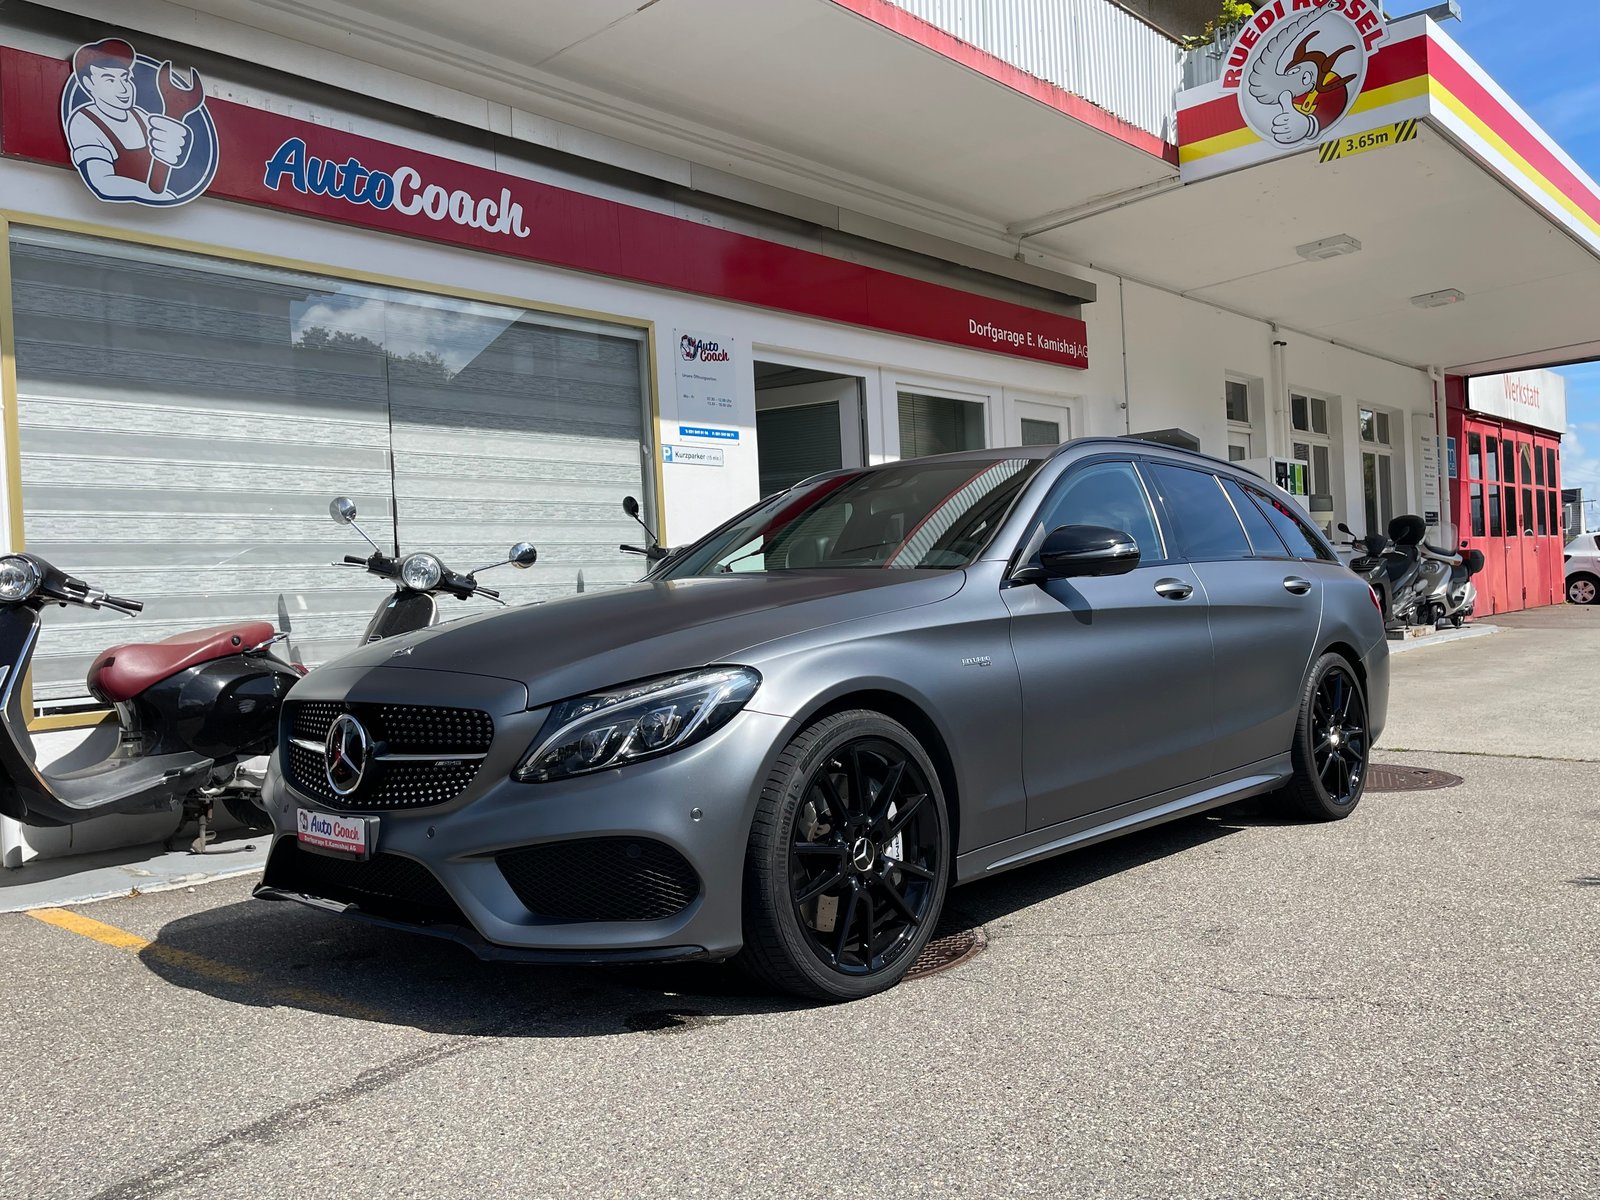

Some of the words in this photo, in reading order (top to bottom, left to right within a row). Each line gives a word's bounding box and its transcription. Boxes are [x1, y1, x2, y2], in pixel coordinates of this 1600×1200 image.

[1223, 0, 1286, 88] RUEDI
[1346, 132, 1389, 152] 3.65m
[697, 339, 719, 352] Auto
[968, 318, 1025, 347] Dorfgarage
[1027, 332, 1036, 347] E.
[1037, 334, 1077, 359] Kamishaj
[700, 349, 730, 362] Coach
[1503, 373, 1540, 409] Werkstatt
[674, 451, 706, 460] Kurzparker
[311, 815, 332, 836] Auto
[333, 821, 360, 840] Coach
[775, 792, 800, 888] ntinental
